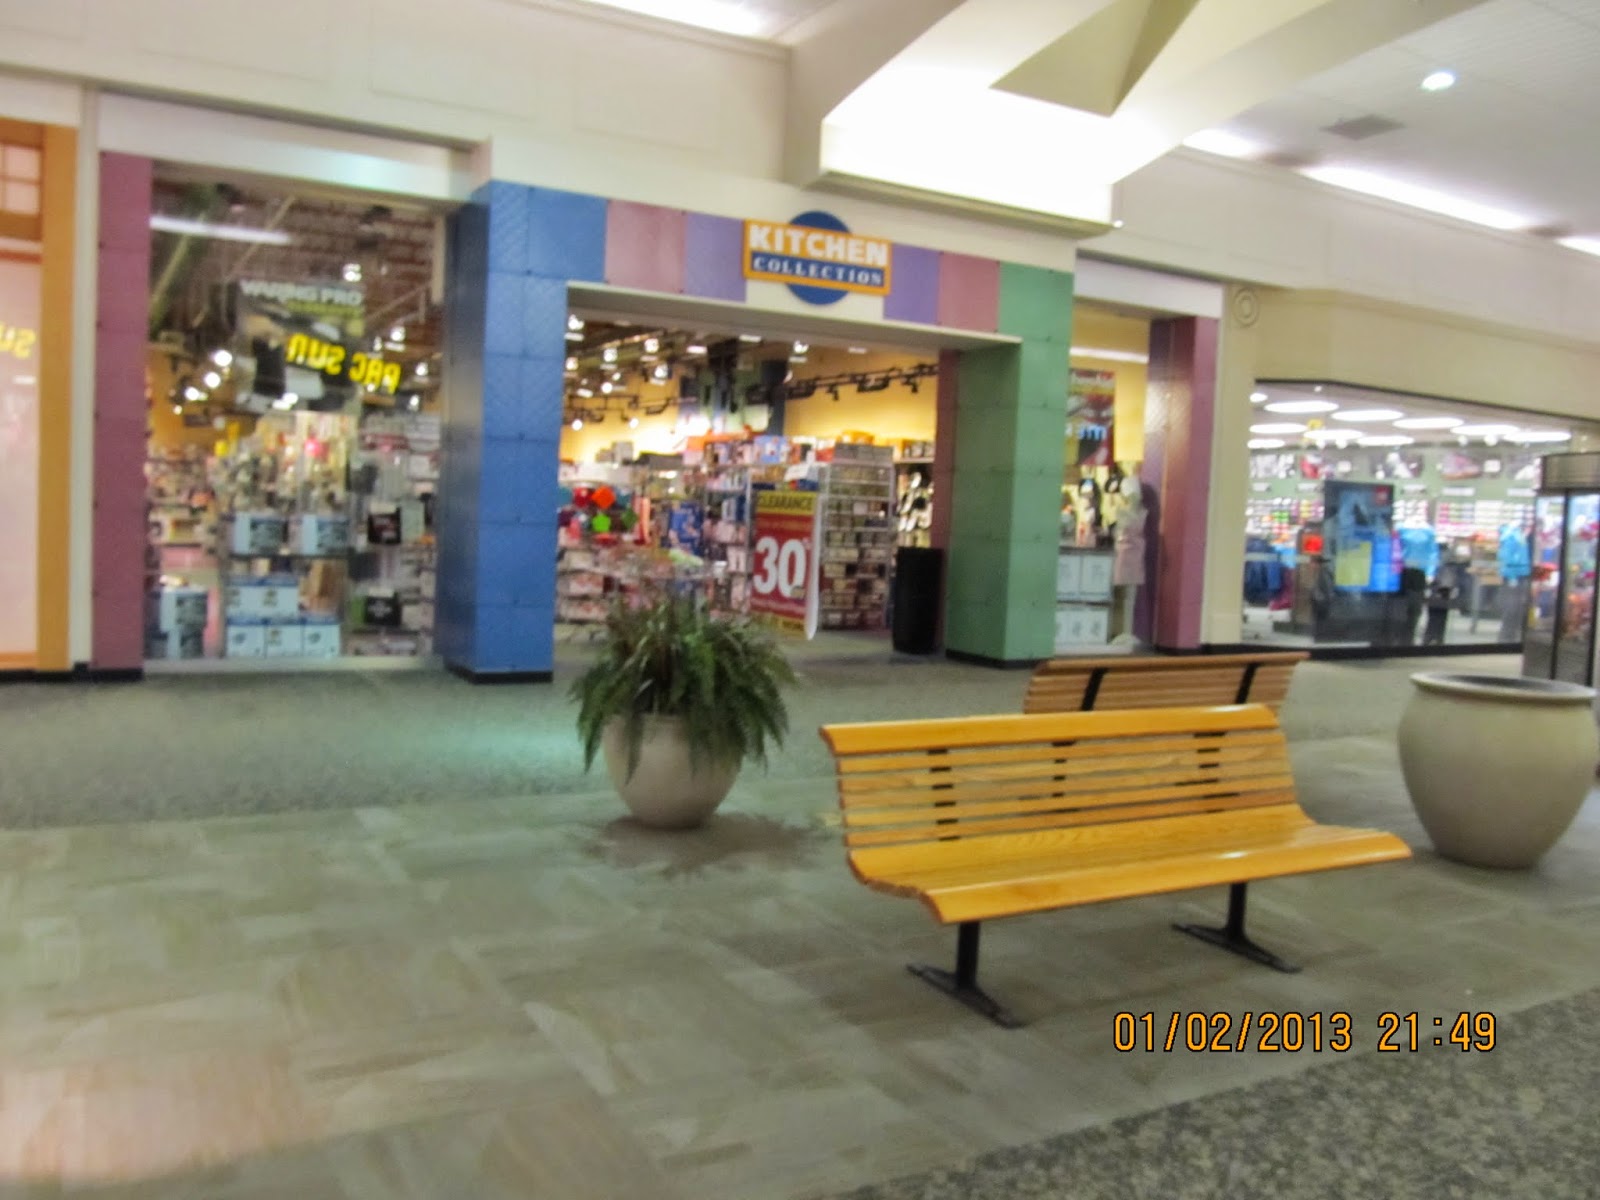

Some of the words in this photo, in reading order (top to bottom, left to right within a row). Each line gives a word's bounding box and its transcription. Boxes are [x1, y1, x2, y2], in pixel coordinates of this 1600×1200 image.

[749, 224, 888, 266] KITCHEN
[753, 256, 883, 286] COLLECTION
[757, 494, 814, 511] CLEARANCE
